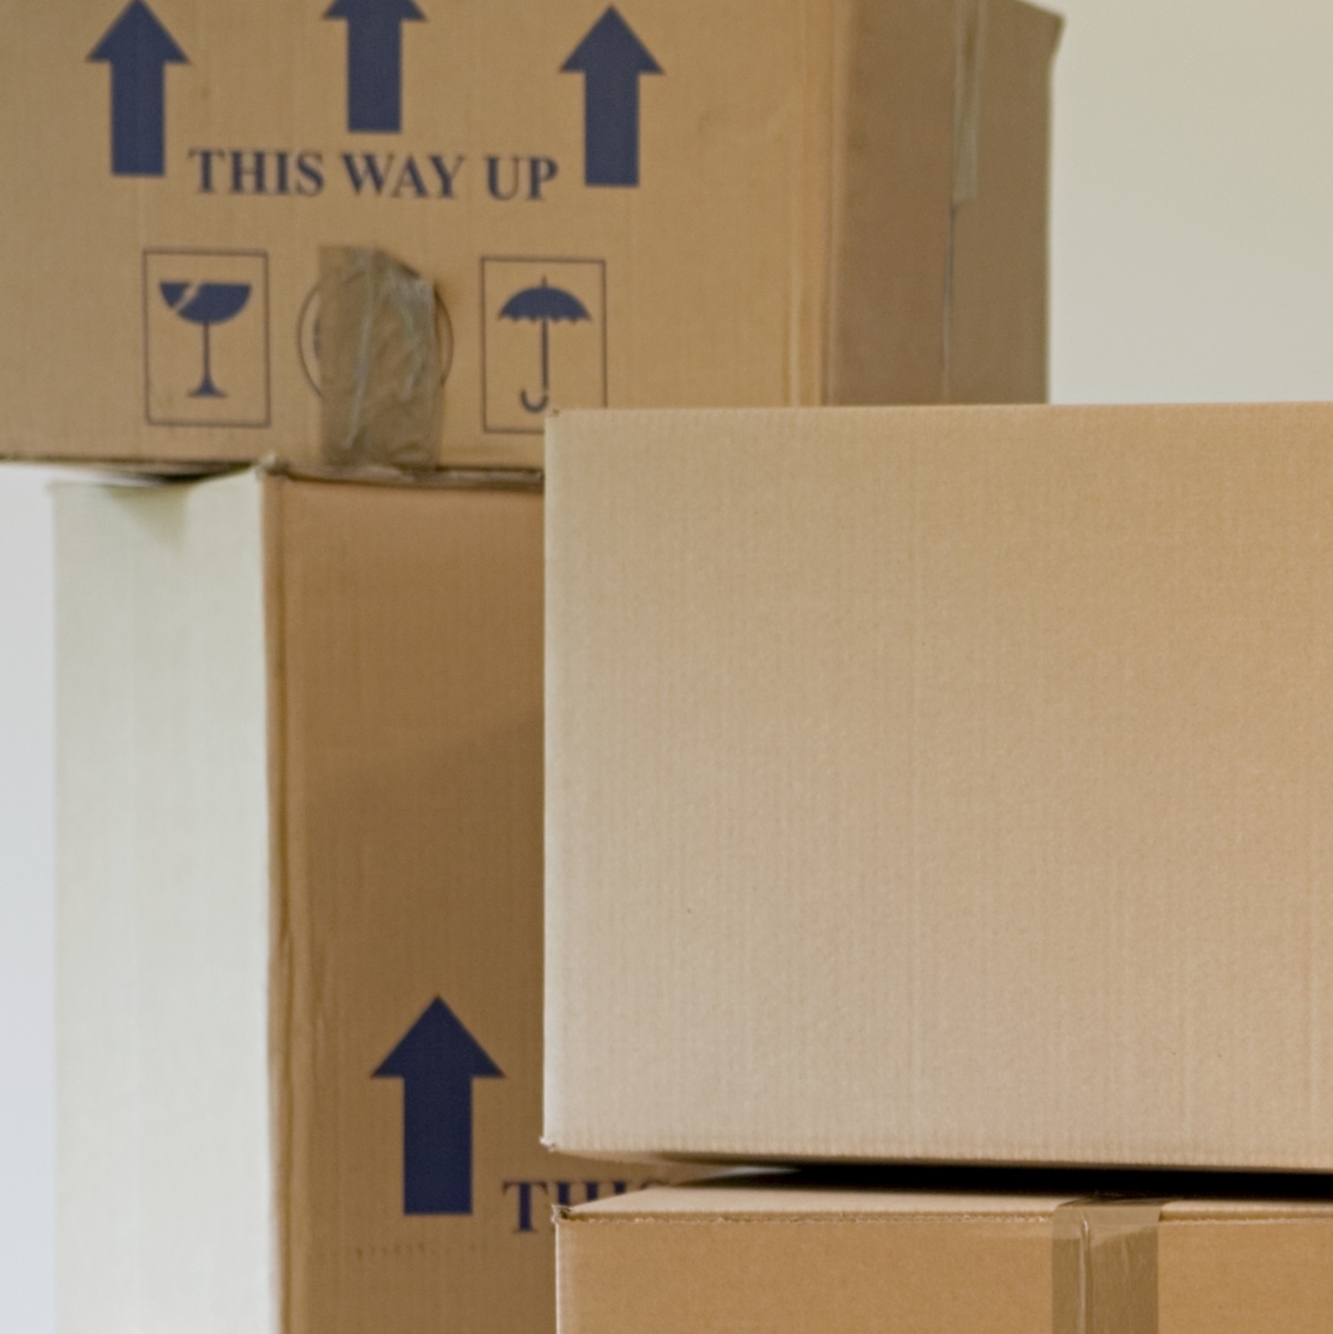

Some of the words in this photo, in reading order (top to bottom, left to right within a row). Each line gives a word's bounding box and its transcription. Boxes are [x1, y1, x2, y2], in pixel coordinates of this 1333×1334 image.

[187, 149, 325, 197] THIS
[341, 151, 465, 199] WAY
[484, 155, 559, 201] UP
